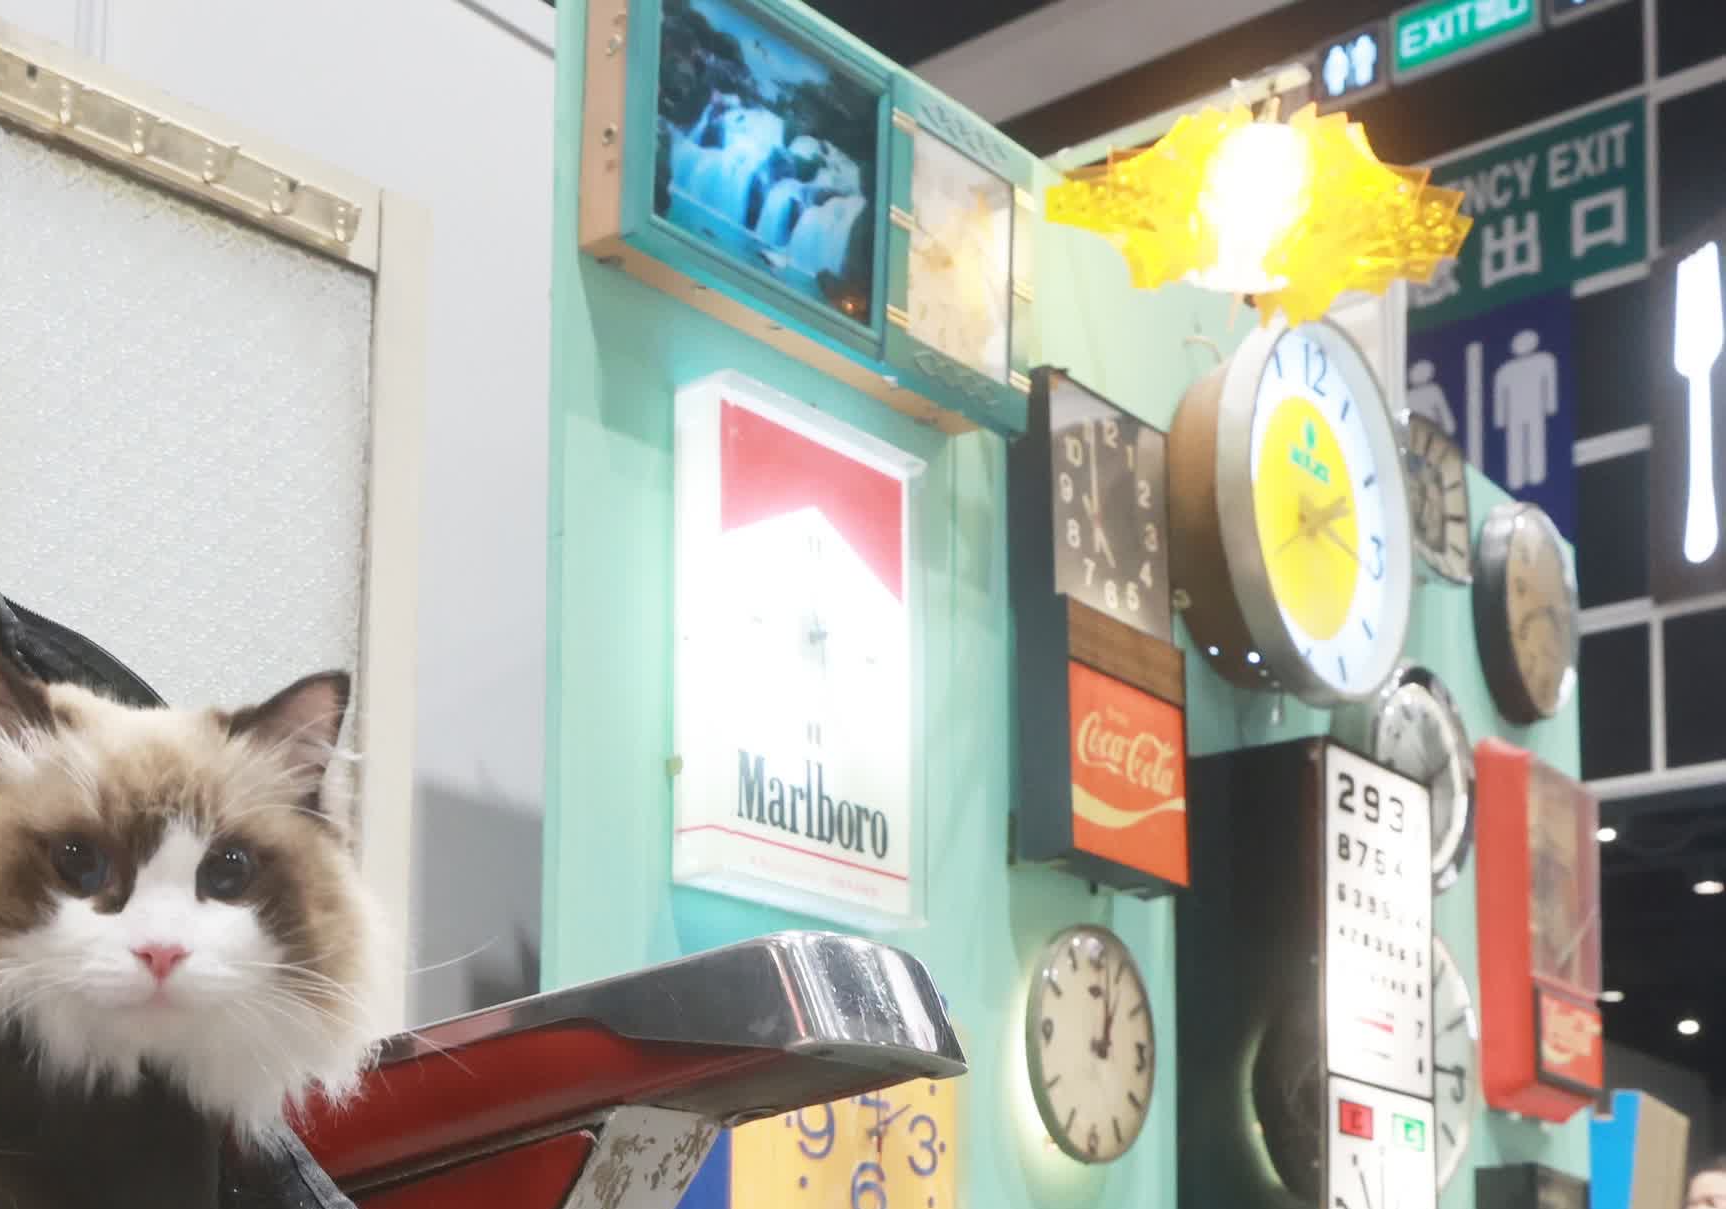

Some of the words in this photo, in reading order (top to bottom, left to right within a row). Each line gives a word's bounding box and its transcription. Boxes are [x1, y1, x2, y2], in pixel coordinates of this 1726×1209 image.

[1400, 2, 1473, 59] EXIT
[1446, 153, 1537, 214] NCY
[1547, 123, 1632, 188] EXIT
[1137, 480, 1151, 509] 2
[1067, 518, 1081, 549] 8
[1083, 557, 1096, 587] 7
[1139, 561, 1153, 589] 4
[737, 748, 888, 860] Marlboro
[797, 1102, 835, 1160] 9
[908, 1114, 938, 1177] 3
